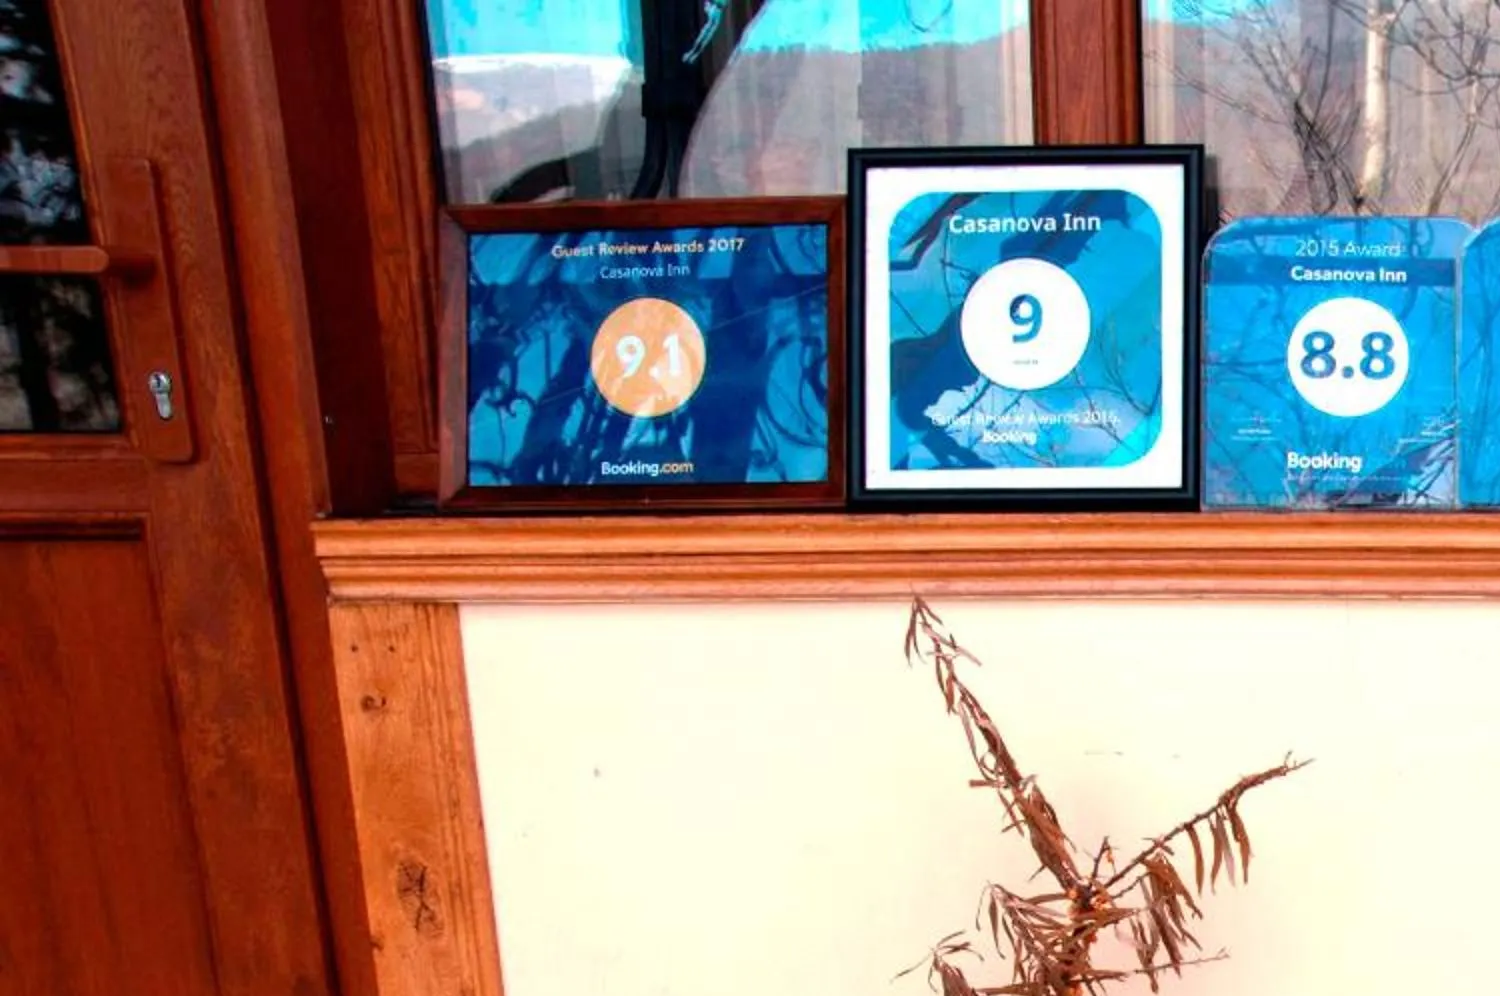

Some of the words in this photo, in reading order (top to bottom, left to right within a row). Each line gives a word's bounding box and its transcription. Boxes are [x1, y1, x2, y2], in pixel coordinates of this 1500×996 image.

[950, 213, 1057, 233] Casanova
[1063, 212, 1101, 231] Inn
[551, 244, 594, 259] Guest
[598, 241, 649, 256] Review
[652, 239, 705, 254] Awards
[708, 237, 745, 253] 2017
[1296, 240, 1339, 256] 2015
[600, 264, 663, 279] Casanova
[667, 263, 691, 278] Inn
[1290, 266, 1375, 283] Casanova
[1379, 267, 1407, 283] Inn
[1009, 294, 1044, 344] 9
[615, 333, 682, 379] 9.1
[1300, 330, 1396, 380] 8.8
[982, 430, 1038, 445] Booking
[600, 460, 694, 477] Booking.com
[1287, 451, 1363, 472] Booking
